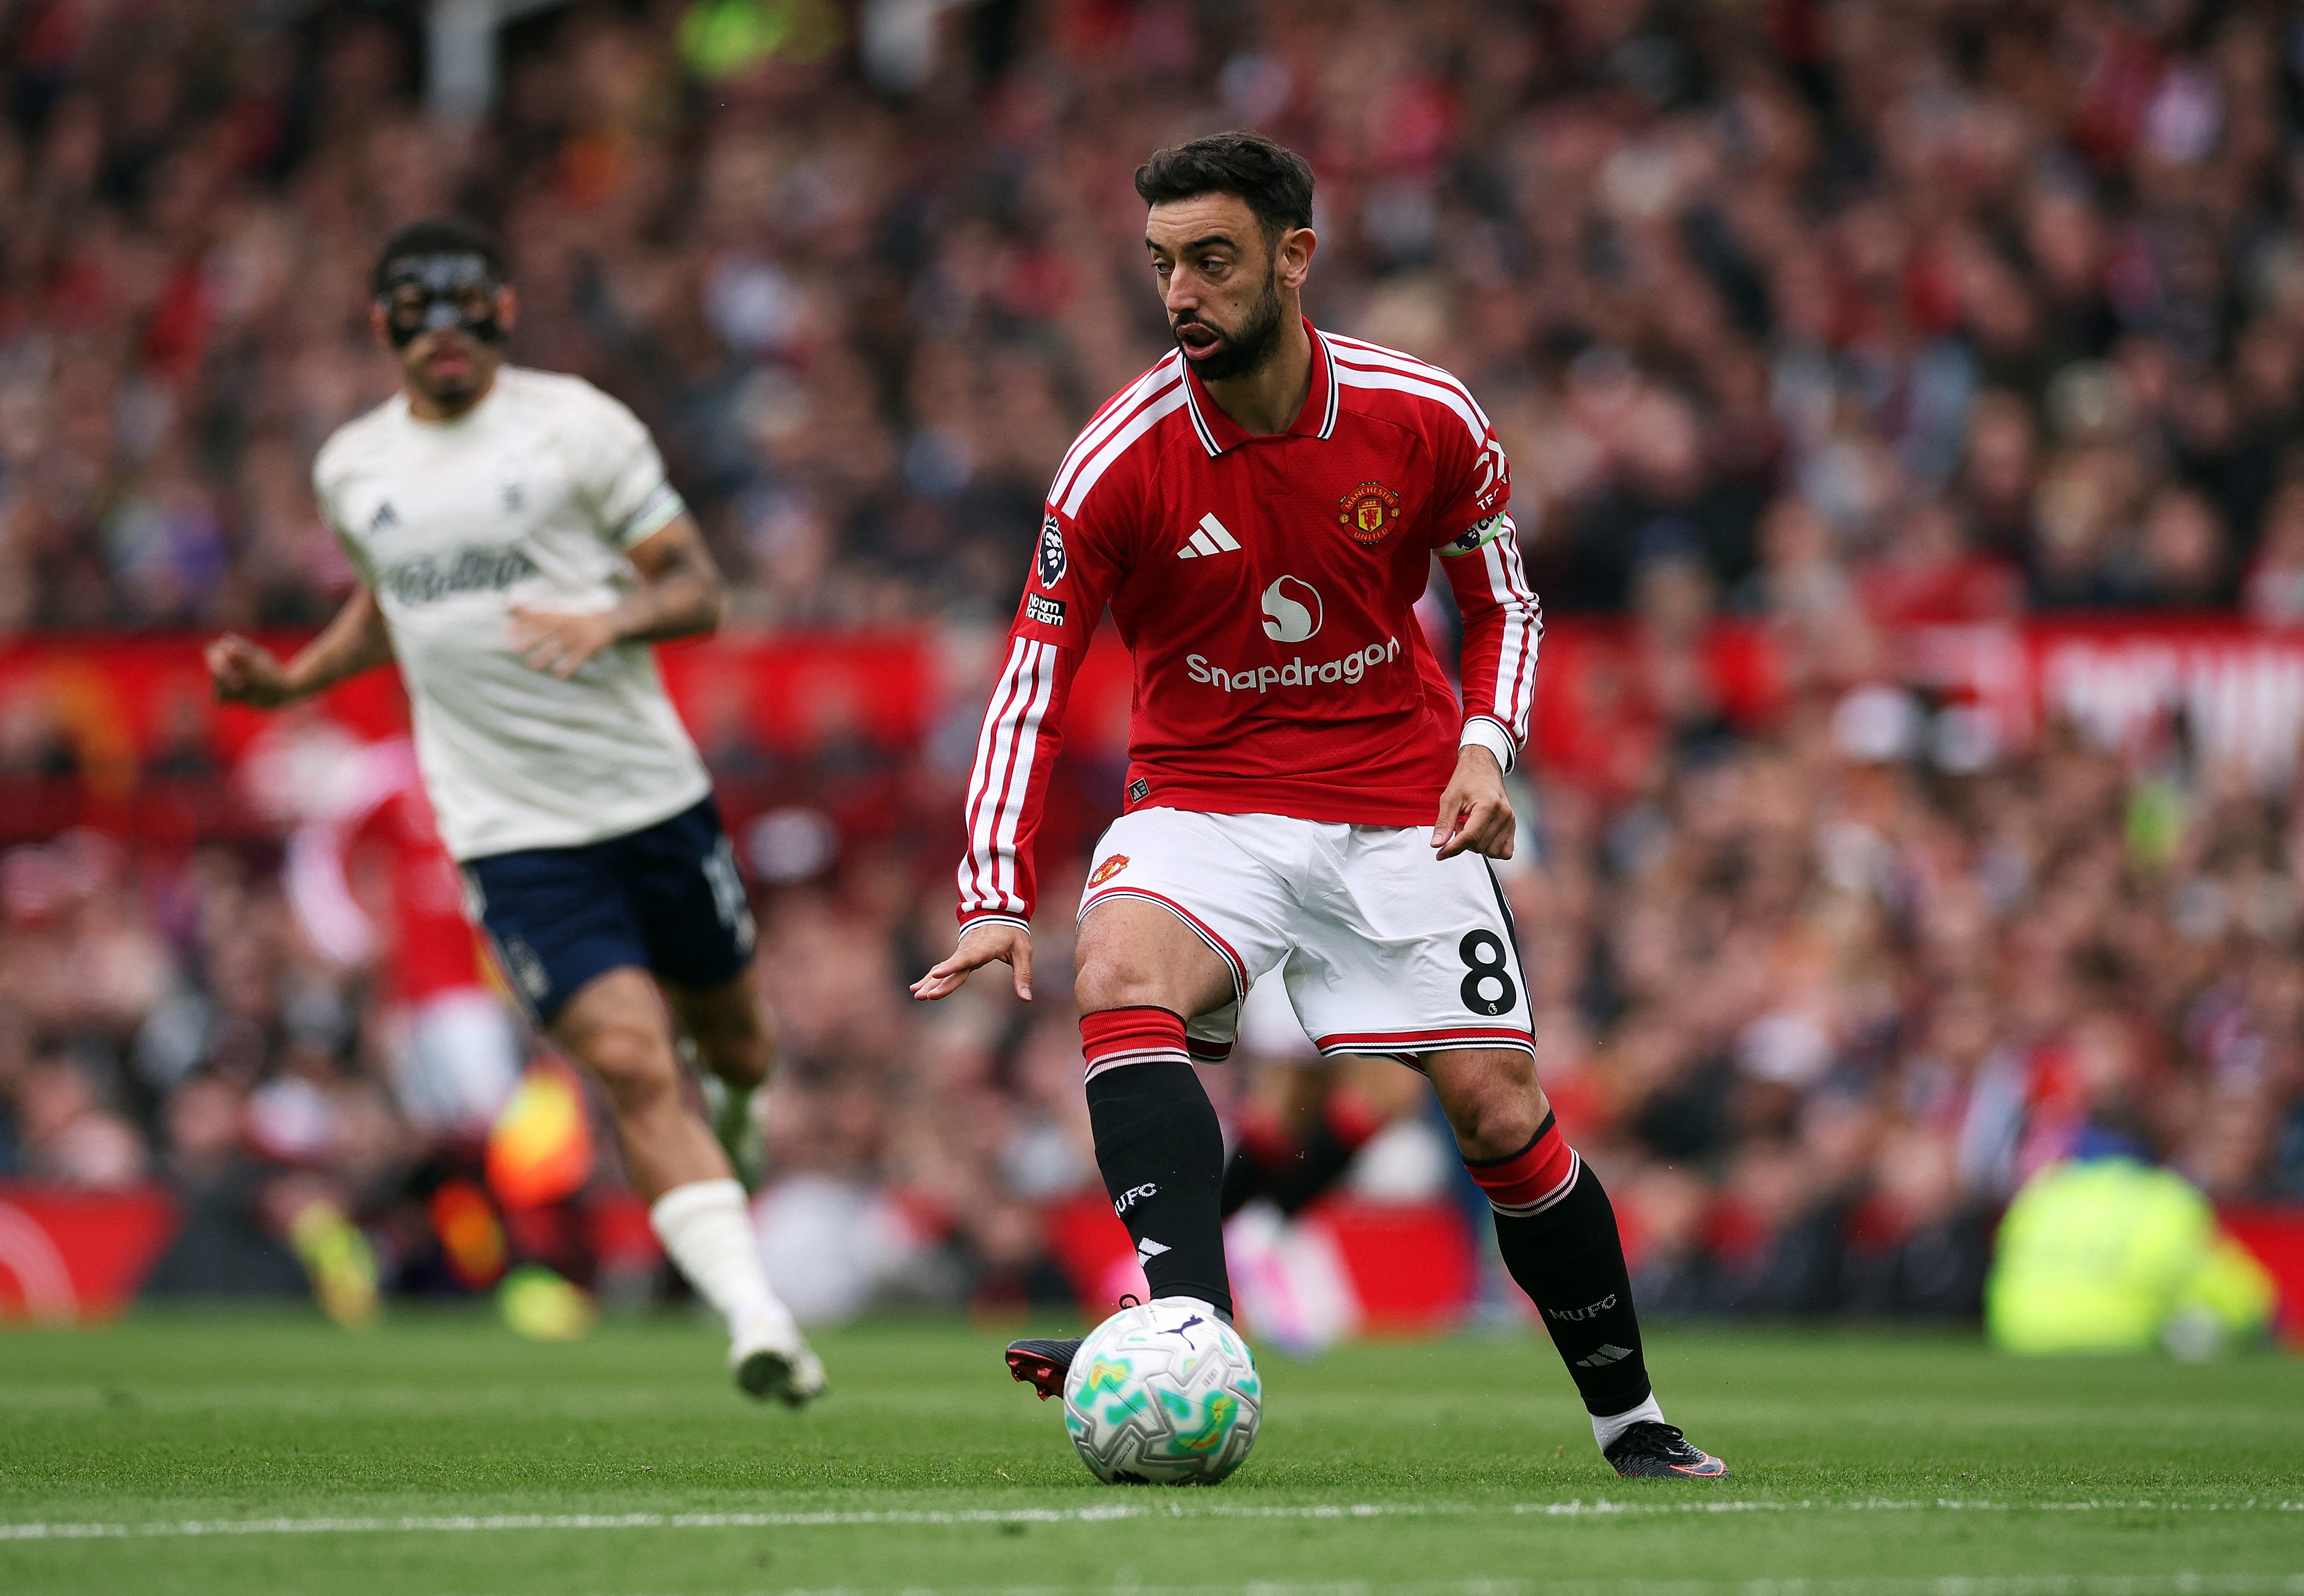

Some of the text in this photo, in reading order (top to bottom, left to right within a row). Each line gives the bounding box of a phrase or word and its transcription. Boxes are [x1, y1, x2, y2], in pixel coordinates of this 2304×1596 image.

[1345, 487, 1394, 509] MANCHESTER
[1354, 528, 1388, 541] UNITED
[1028, 593, 1040, 608] No
[1186, 636, 1400, 694] Snapdragon
[1459, 929, 1517, 1016] 8
[1114, 1182, 1157, 1219] UFC
[1547, 1294, 1617, 1321] MUFC
